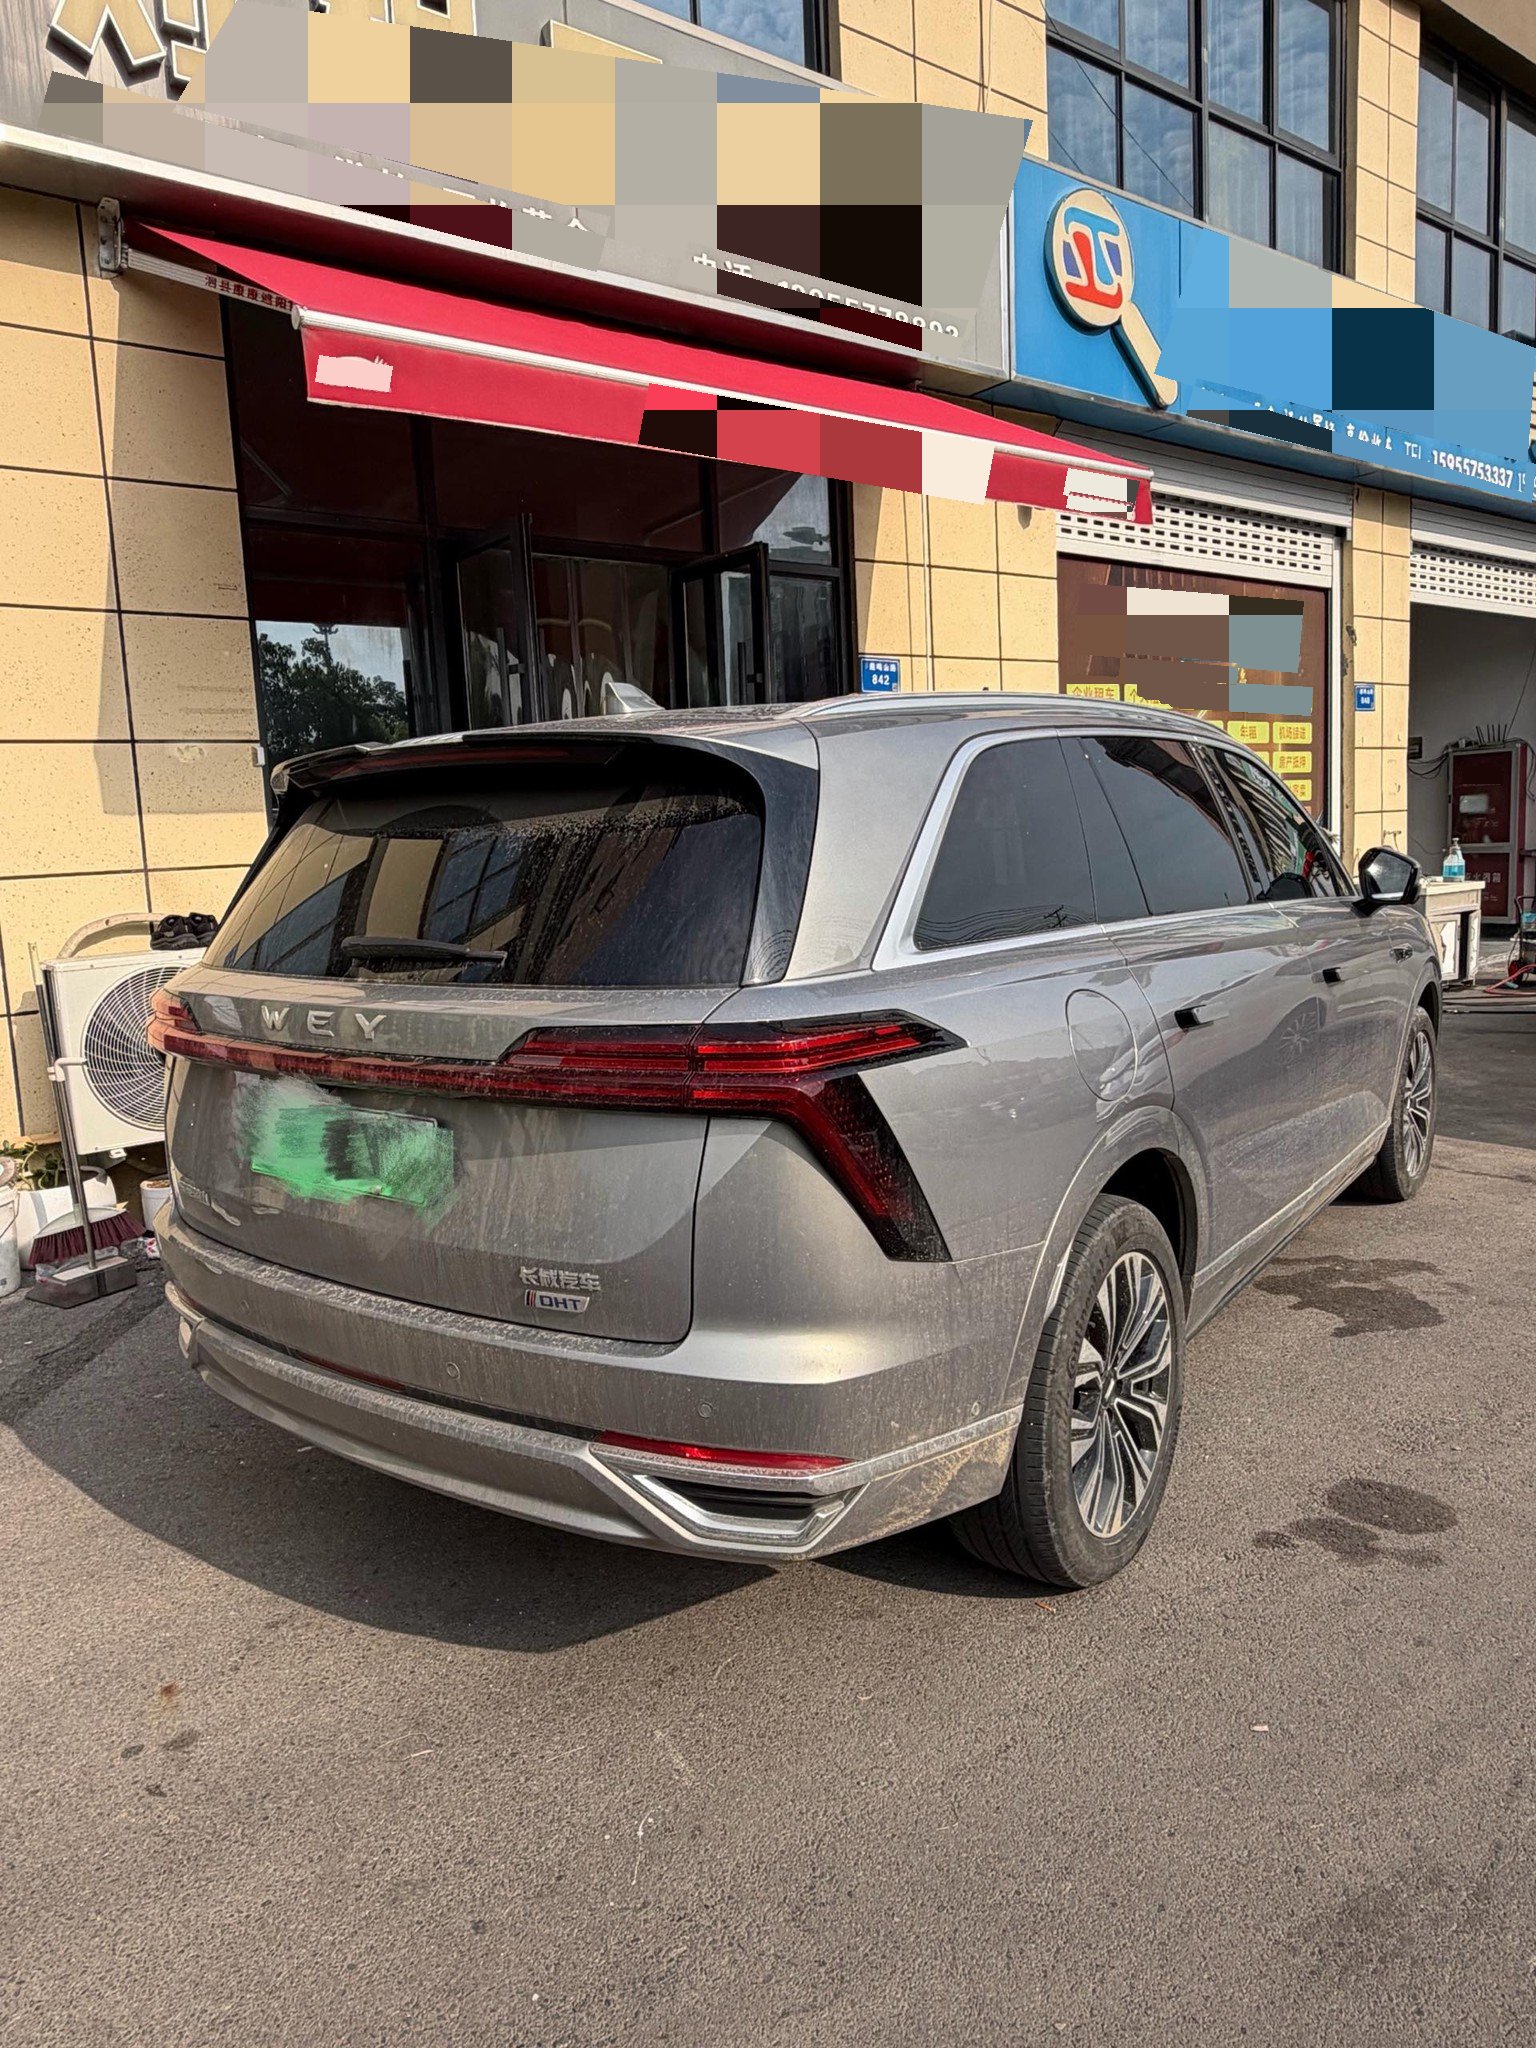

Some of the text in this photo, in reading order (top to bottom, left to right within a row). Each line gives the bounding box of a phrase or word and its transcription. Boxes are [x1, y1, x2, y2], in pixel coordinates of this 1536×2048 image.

[871, 673, 890, 686] 842
[261, 1004, 387, 1041] WEY
[539, 1294, 582, 1311] DHT
